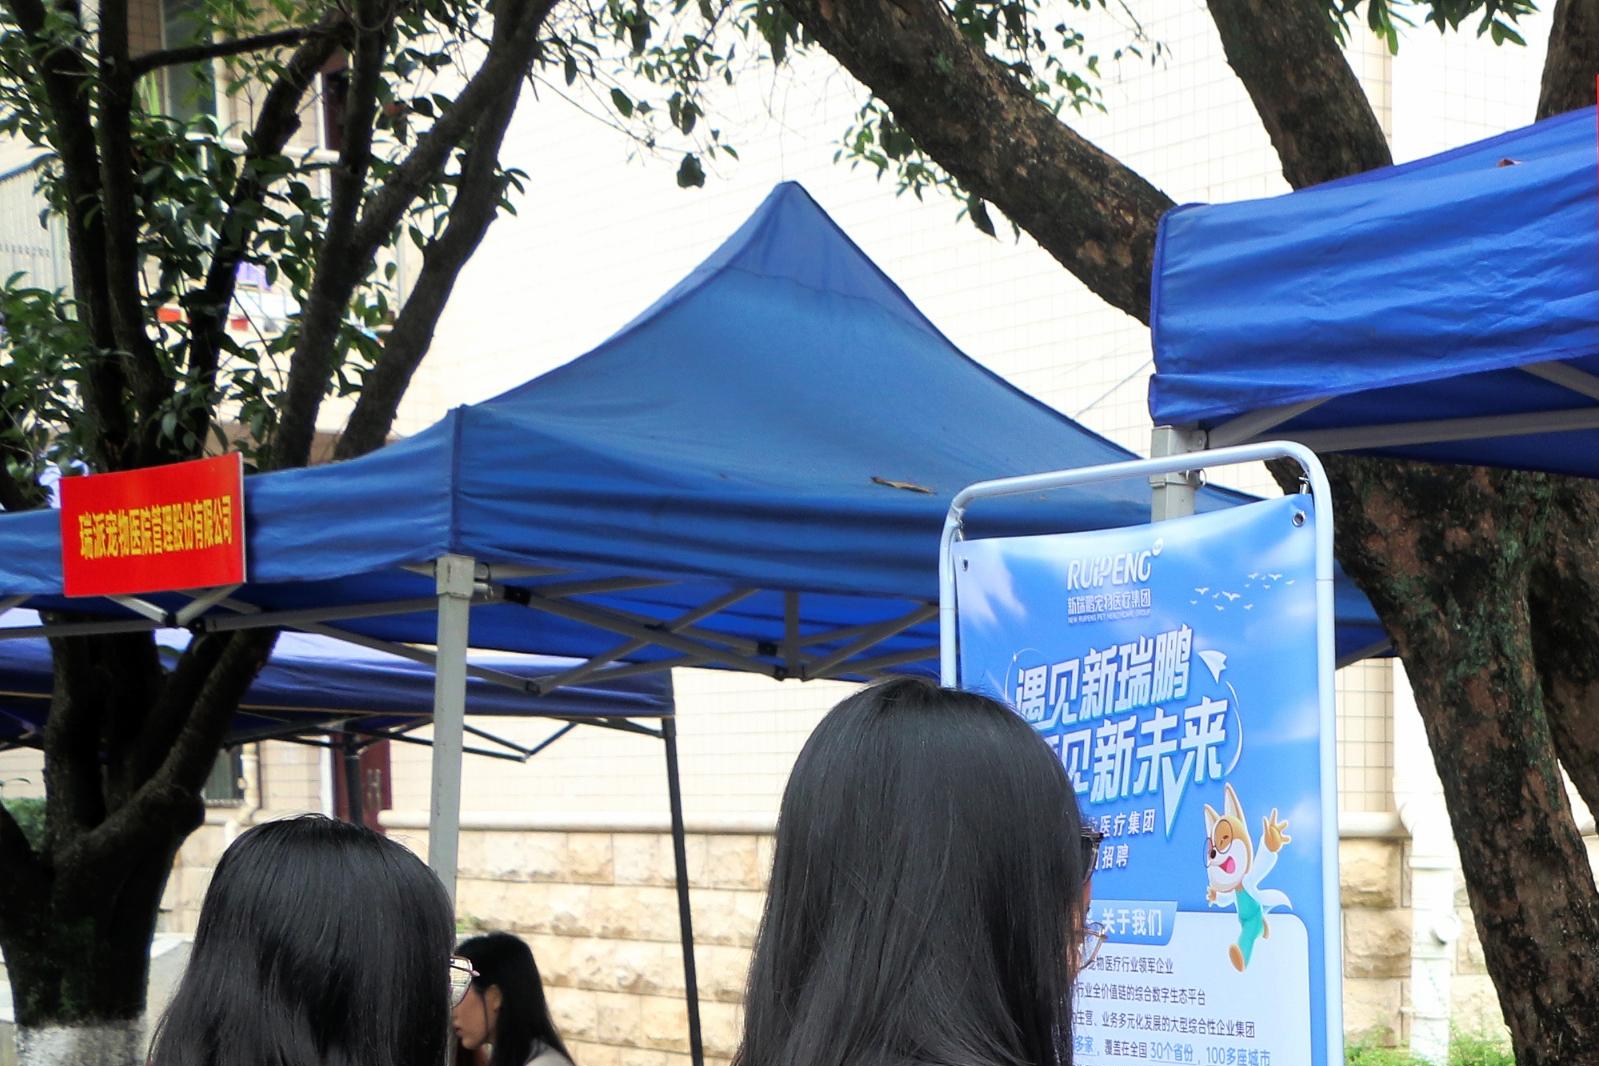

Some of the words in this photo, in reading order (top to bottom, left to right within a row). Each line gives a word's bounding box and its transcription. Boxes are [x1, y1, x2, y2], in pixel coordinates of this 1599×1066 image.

[78, 495, 232, 560] 瑞派宠物医院管理股份有限公司
[1015, 623, 1194, 731] 遇见新瑞鹏
[1095, 843, 1129, 870] 招聘
[1102, 907, 1162, 937] 关于我们
